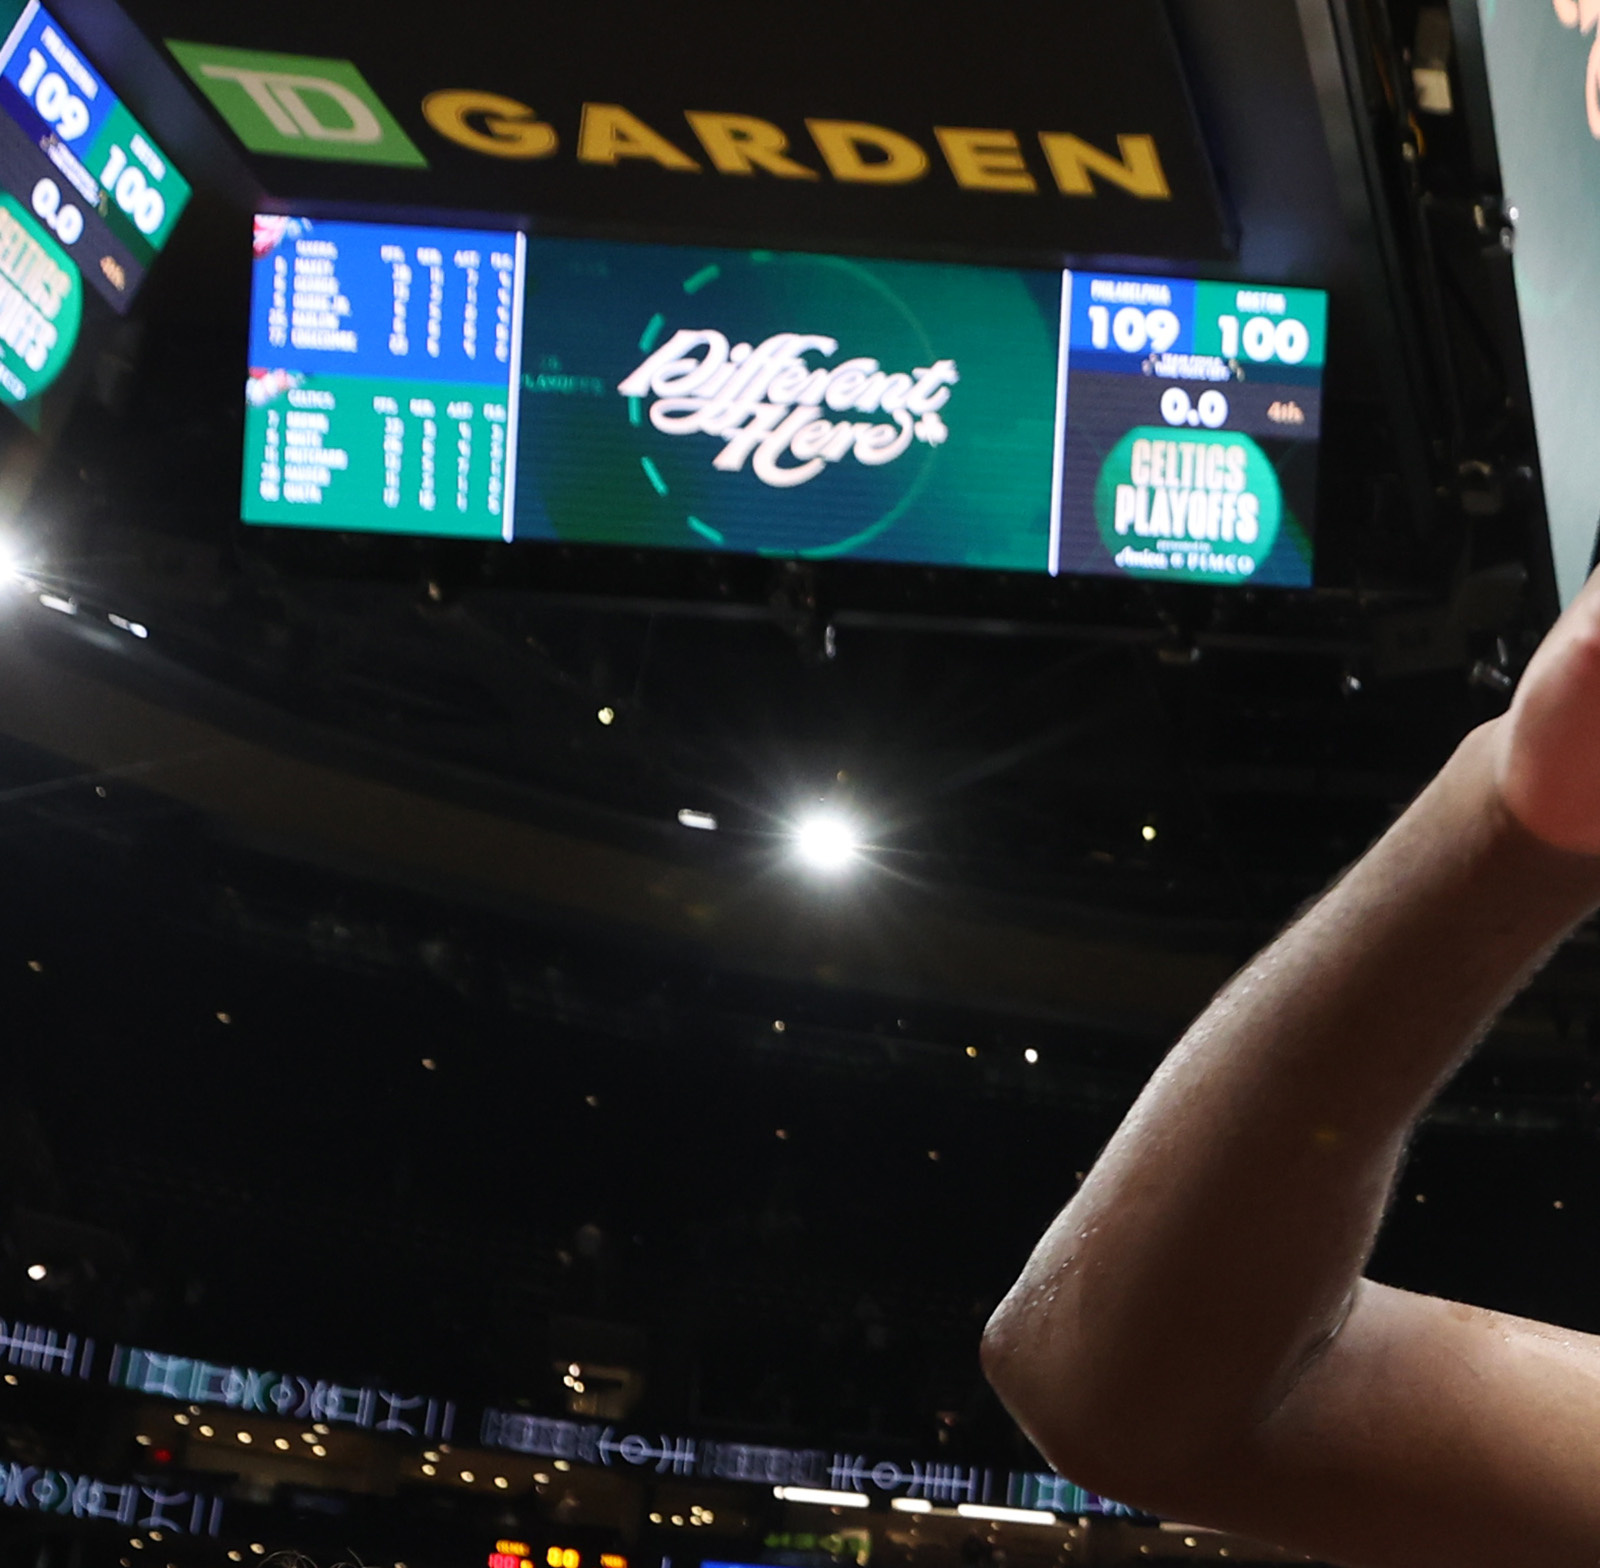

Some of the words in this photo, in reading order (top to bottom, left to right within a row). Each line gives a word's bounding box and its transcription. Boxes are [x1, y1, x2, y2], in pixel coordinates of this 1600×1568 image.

[19, 48, 90, 141] 109
[200, 64, 382, 143] TD
[421, 88, 1171, 199] GARDEN
[31, 177, 84, 245] 0.0
[100, 144, 166, 235] 100
[1088, 305, 1180, 354] 109
[1218, 314, 1309, 364] 100
[617, 329, 959, 416] Different
[1160, 387, 1228, 428] 0.0
[649, 396, 913, 488] Here
[1130, 438, 1247, 492] CELTICS
[1114, 484, 1260, 544] PLAYOFFS
